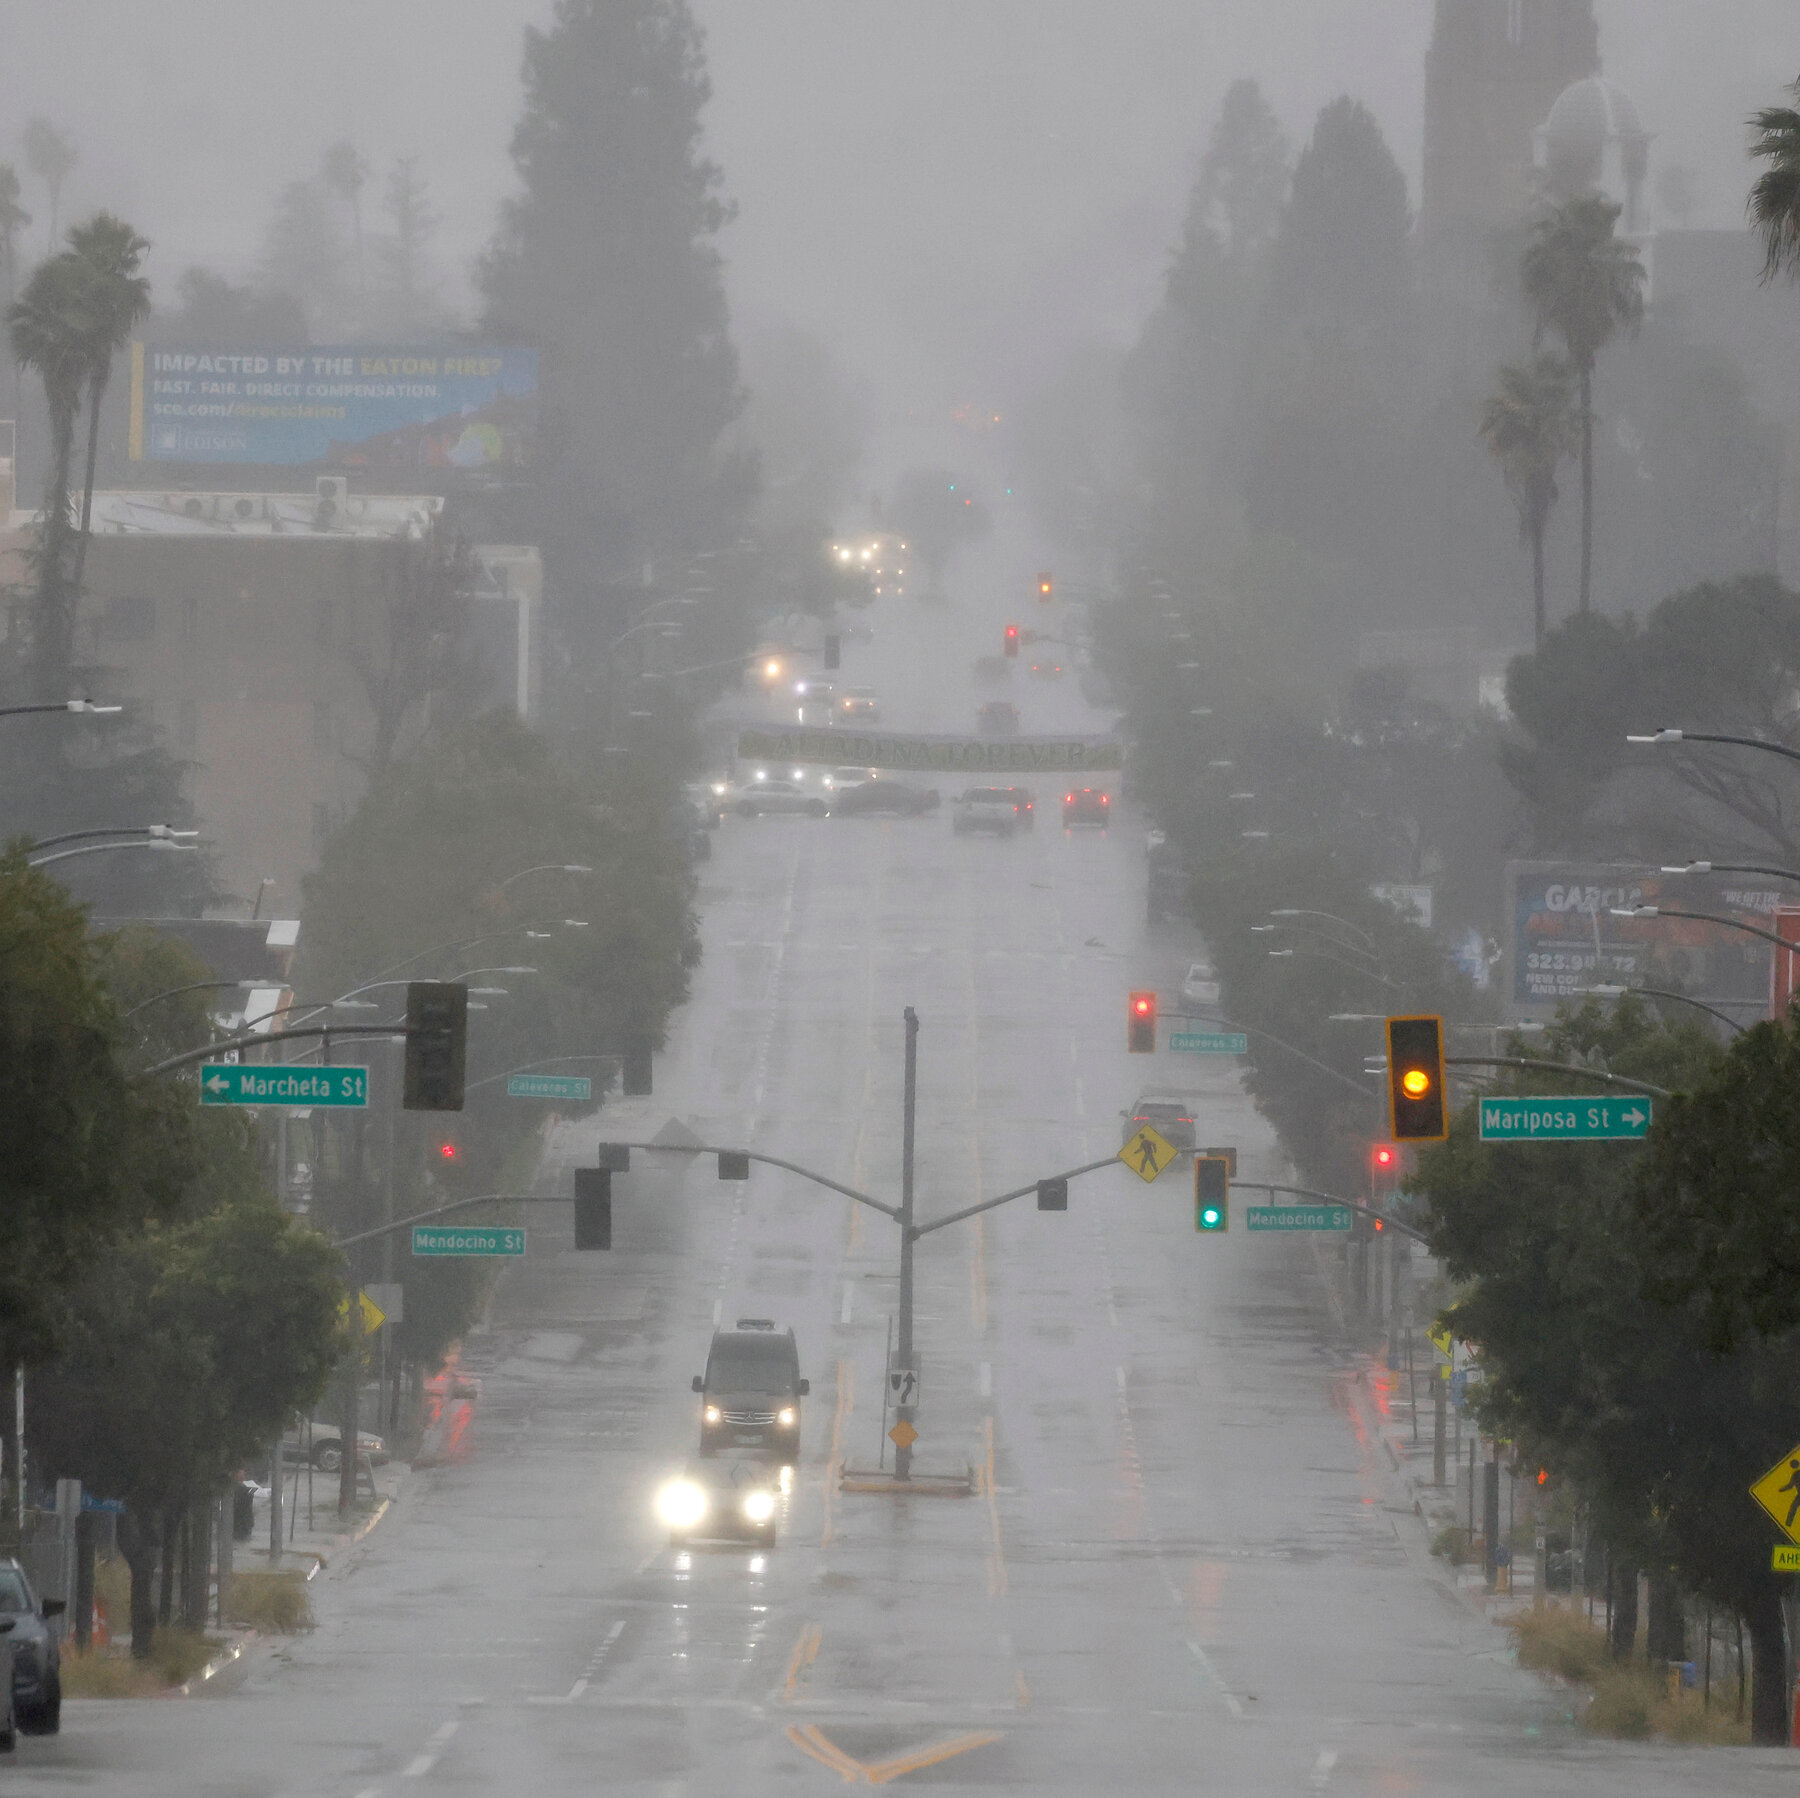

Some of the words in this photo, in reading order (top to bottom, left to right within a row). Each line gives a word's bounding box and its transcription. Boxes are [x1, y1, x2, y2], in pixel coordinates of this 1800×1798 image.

[153, 353, 269, 374] IMPACTED
[276, 356, 306, 374] BY
[311, 357, 353, 375] THE
[360, 357, 438, 375] EATON
[444, 357, 504, 376] FIRE?
[153, 379, 196, 394] FAST.
[200, 381, 240, 394] FAIR.
[246, 382, 300, 396] DIRECT
[306, 383, 441, 398] COMPENSATION.
[771, 736, 932, 763] ALTADENA
[947, 742, 1087, 766] FOREVER
[1231, 1038, 1244, 1049] St
[240, 1075, 331, 1098] Marcheta
[341, 1076, 363, 1099] St
[574, 1082, 587, 1095] St
[1485, 1108, 1577, 1134] Mariposa
[1587, 1108, 1610, 1129] St
[1249, 1211, 1325, 1227] Mendocino
[1332, 1212, 1349, 1226] St
[416, 1233, 497, 1250] Mendocino
[504, 1234, 522, 1250] St
